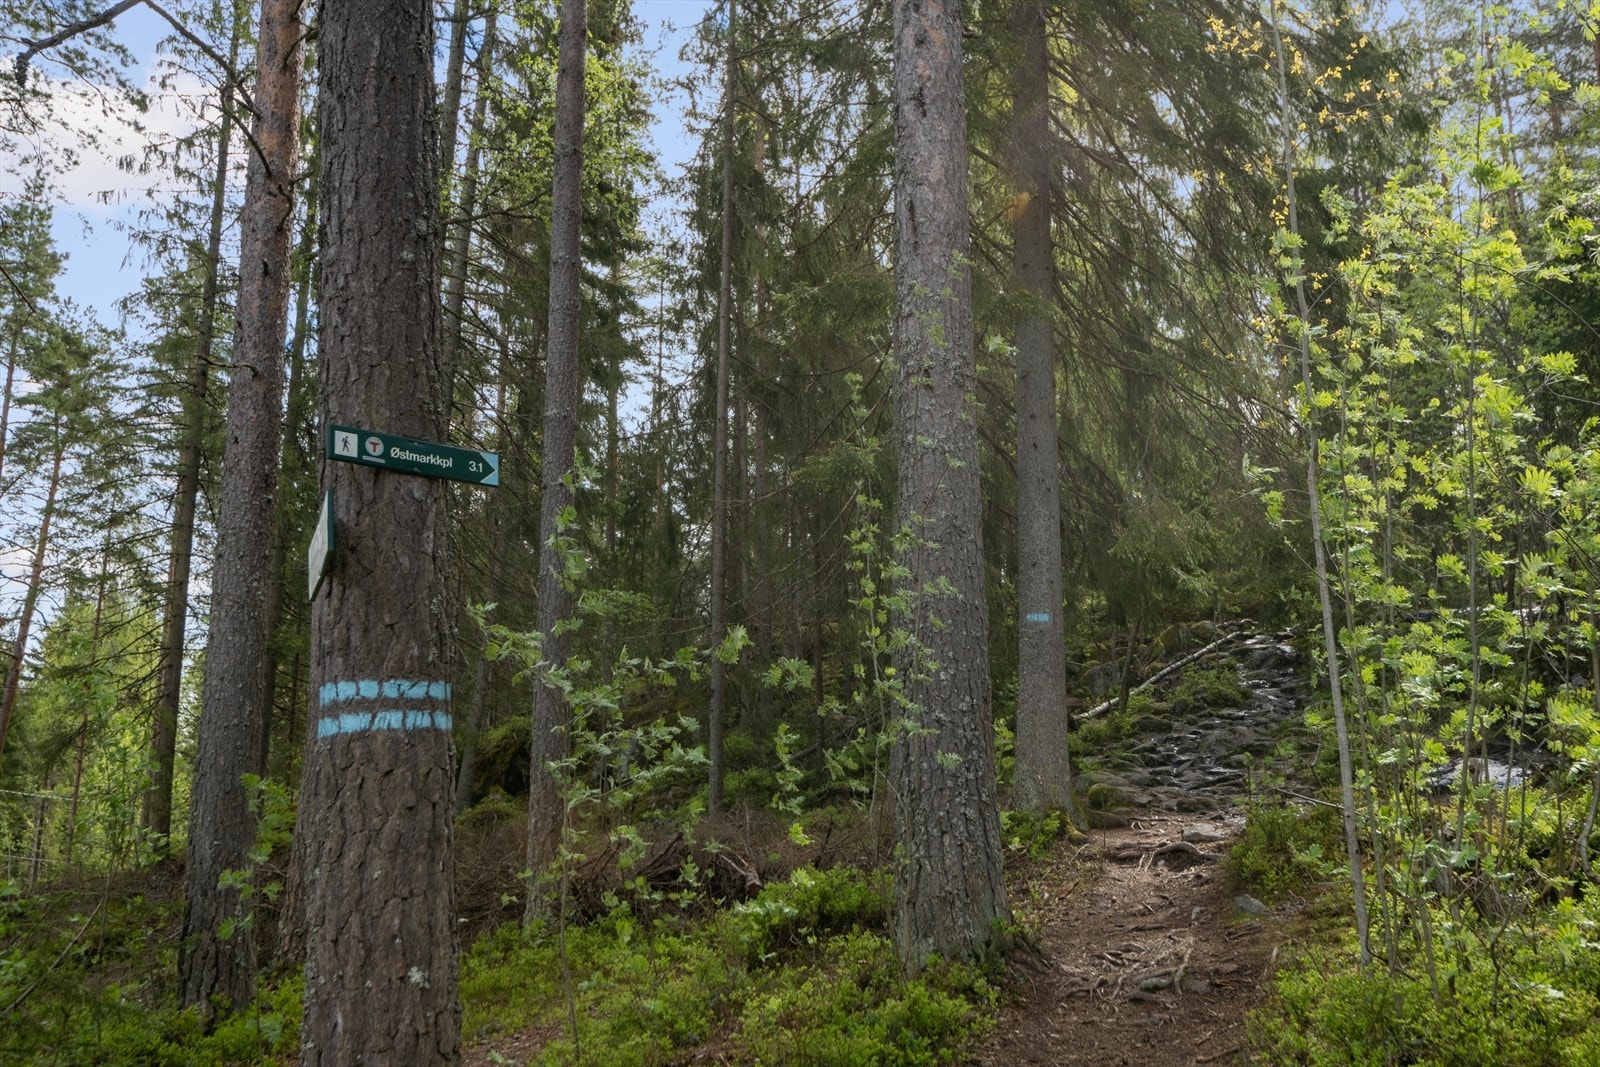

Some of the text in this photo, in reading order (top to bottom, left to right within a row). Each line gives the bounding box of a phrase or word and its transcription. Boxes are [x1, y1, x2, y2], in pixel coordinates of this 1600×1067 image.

[370, 441, 483, 472] T Østmarkkpl 3.1
